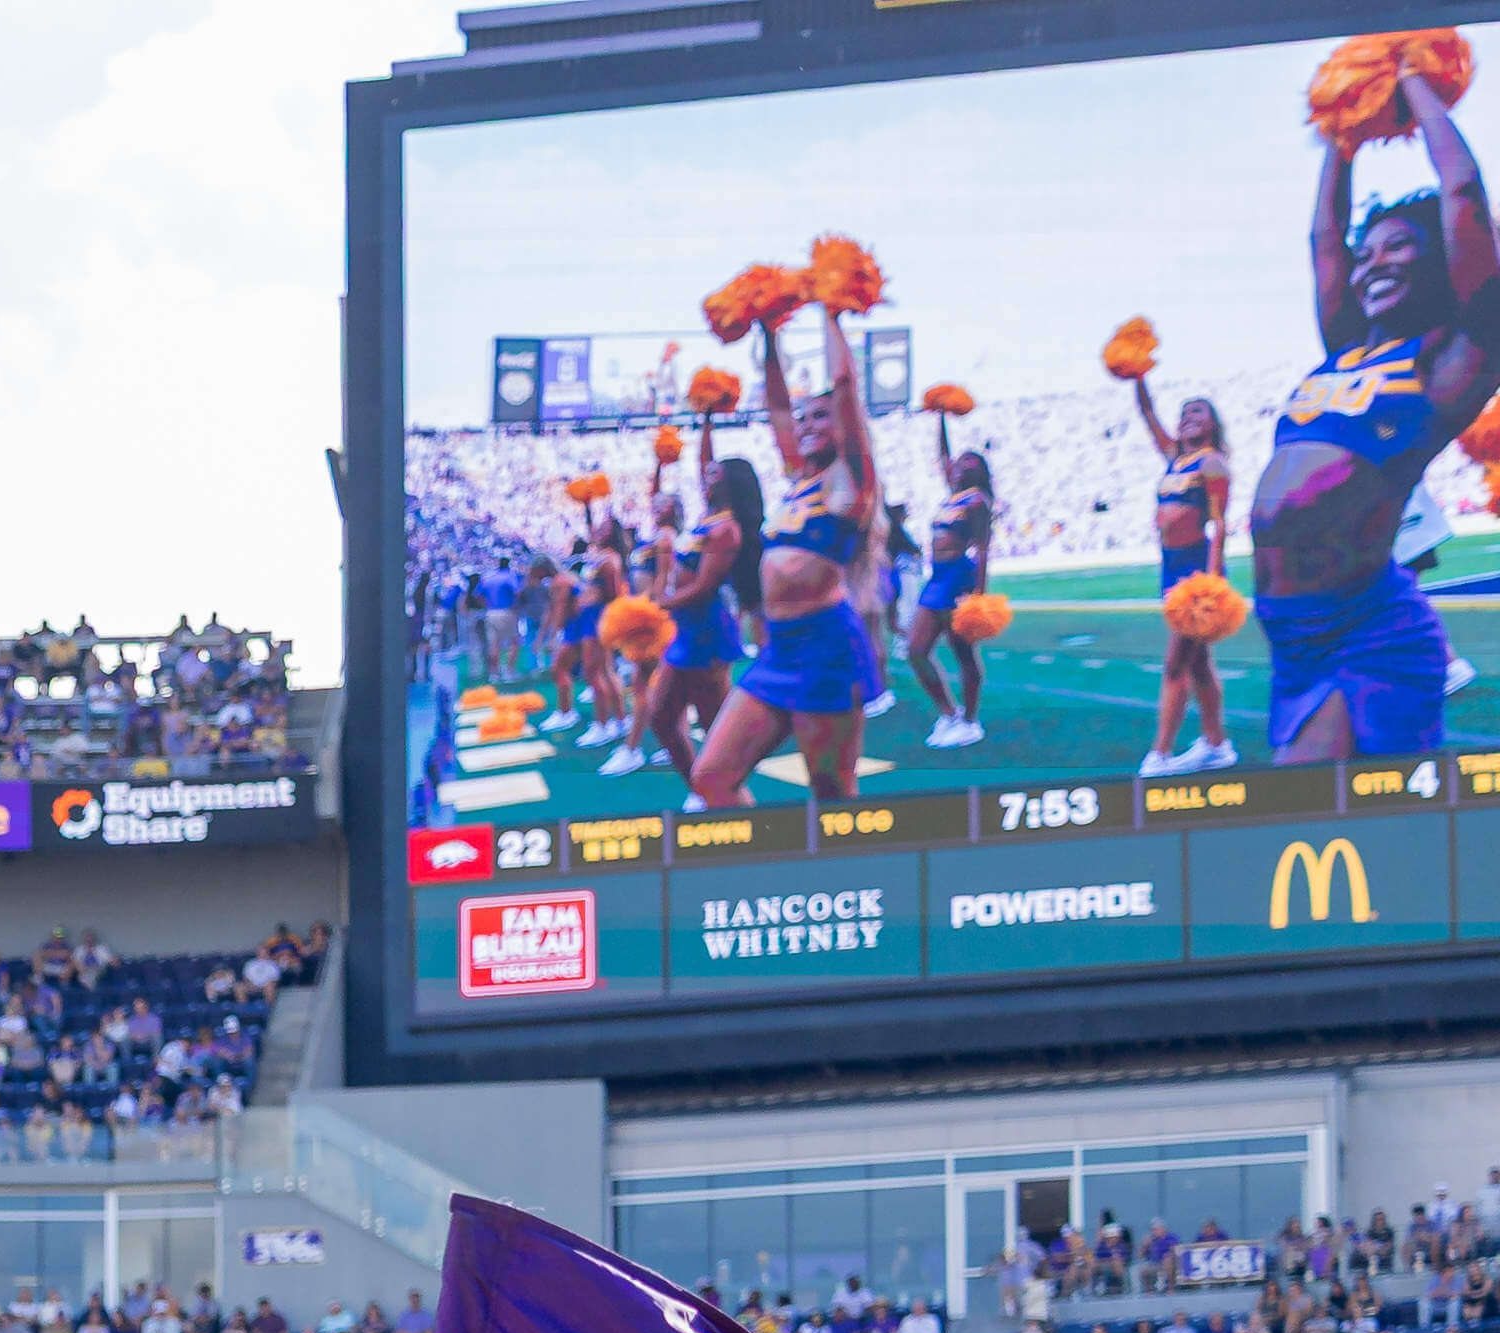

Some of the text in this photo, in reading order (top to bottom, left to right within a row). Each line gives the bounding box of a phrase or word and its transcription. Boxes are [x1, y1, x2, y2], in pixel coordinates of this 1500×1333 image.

[102, 777, 297, 816] Equipment
[1146, 782, 1247, 812] BALL ON
[1407, 759, 1440, 799] 4
[820, 809, 895, 836] TO GO
[999, 786, 1100, 831] 7:53
[102, 813, 209, 846] Share
[677, 819, 753, 848] DOWN
[497, 828, 553, 869] 22
[503, 905, 581, 933] FARM
[701, 888, 884, 929] HANCOCK
[950, 881, 1155, 929] POWERADE
[471, 930, 584, 963] BUREAU
[701, 919, 884, 961] WHITNEY
[1189, 1244, 1251, 1280] 568
